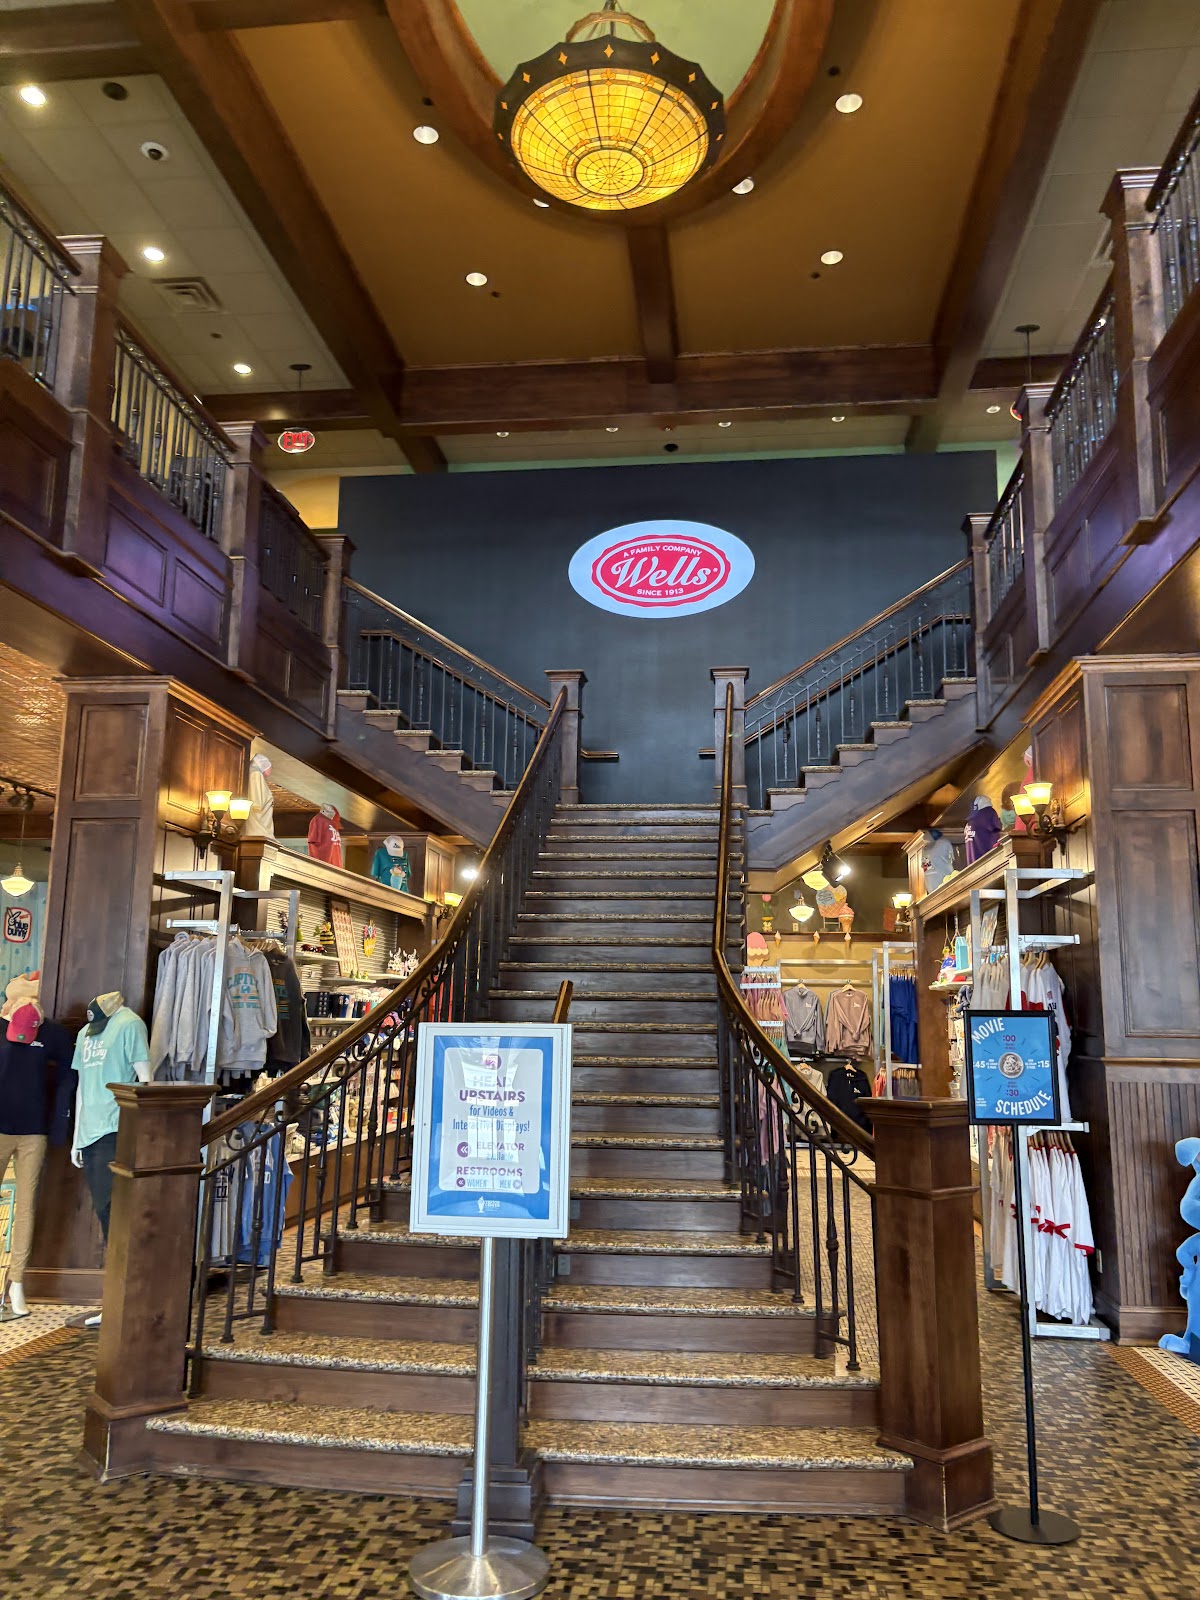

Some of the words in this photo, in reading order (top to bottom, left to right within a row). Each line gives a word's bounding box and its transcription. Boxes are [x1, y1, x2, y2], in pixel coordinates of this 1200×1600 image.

[283, 432, 309, 449] EXIT
[630, 545, 661, 557] FAMILY
[662, 545, 702, 557] COMPANY
[611, 555, 711, 588] Wells
[636, 588, 662, 596] SINCE
[665, 587, 684, 596] 1913
[971, 1017, 1005, 1045] MOVIE
[473, 1076, 513, 1088] HEAD
[459, 1089, 526, 1103] UPSTAIRS
[995, 1089, 1052, 1116] SCHEDULE
[470, 1105, 481, 1115] for
[482, 1105, 507, 1116] Videos
[508, 1106, 514, 1117] &
[496, 1120, 530, 1134] Displays!
[477, 1141, 525, 1151] ELEVATOR
[456, 1166, 523, 1177] RESTROOMS
[466, 1178, 487, 1188] WOMEN
[499, 1179, 512, 1189] MEN
